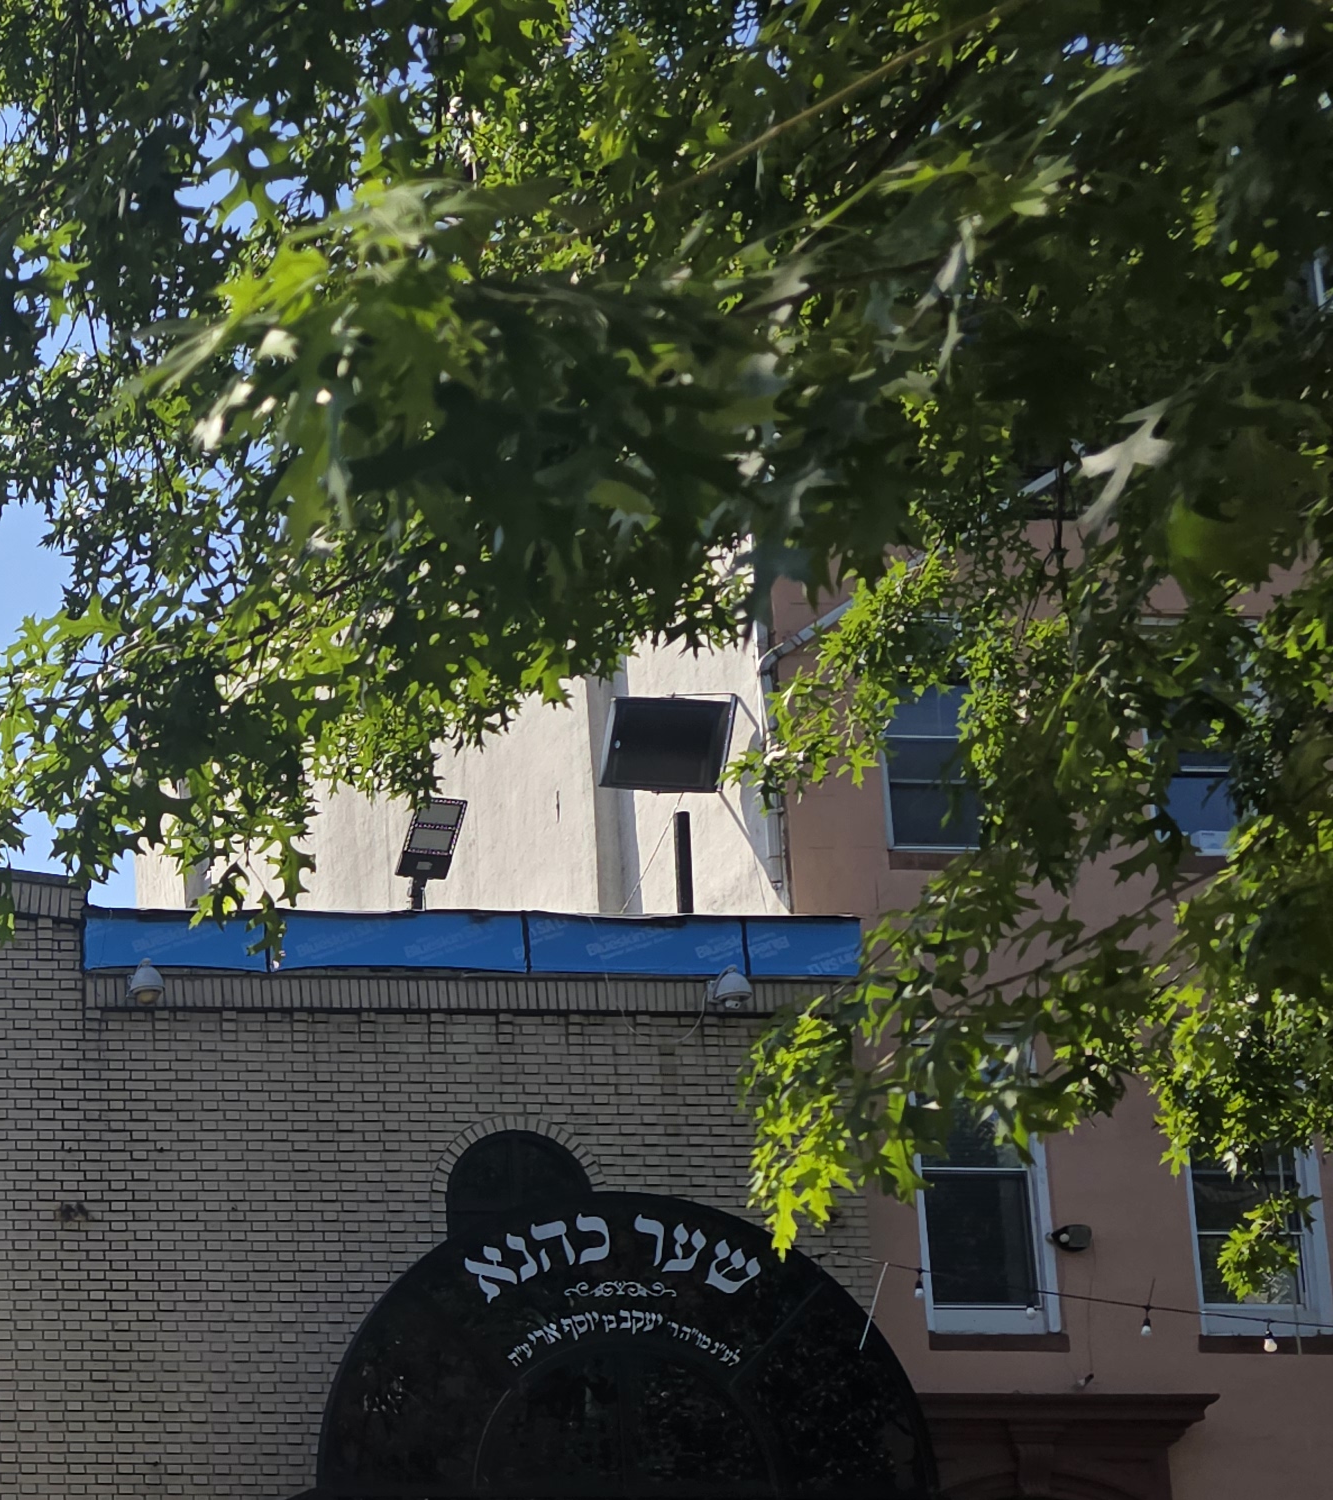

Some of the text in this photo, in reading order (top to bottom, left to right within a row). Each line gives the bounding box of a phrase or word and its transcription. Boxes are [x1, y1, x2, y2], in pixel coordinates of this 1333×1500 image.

[585, 931, 646, 957] Blueskin
[464, 1212, 762, 1304] שער כהנא
[559, 1310, 599, 1341] יוסף
[619, 1309, 663, 1335] יעקב
